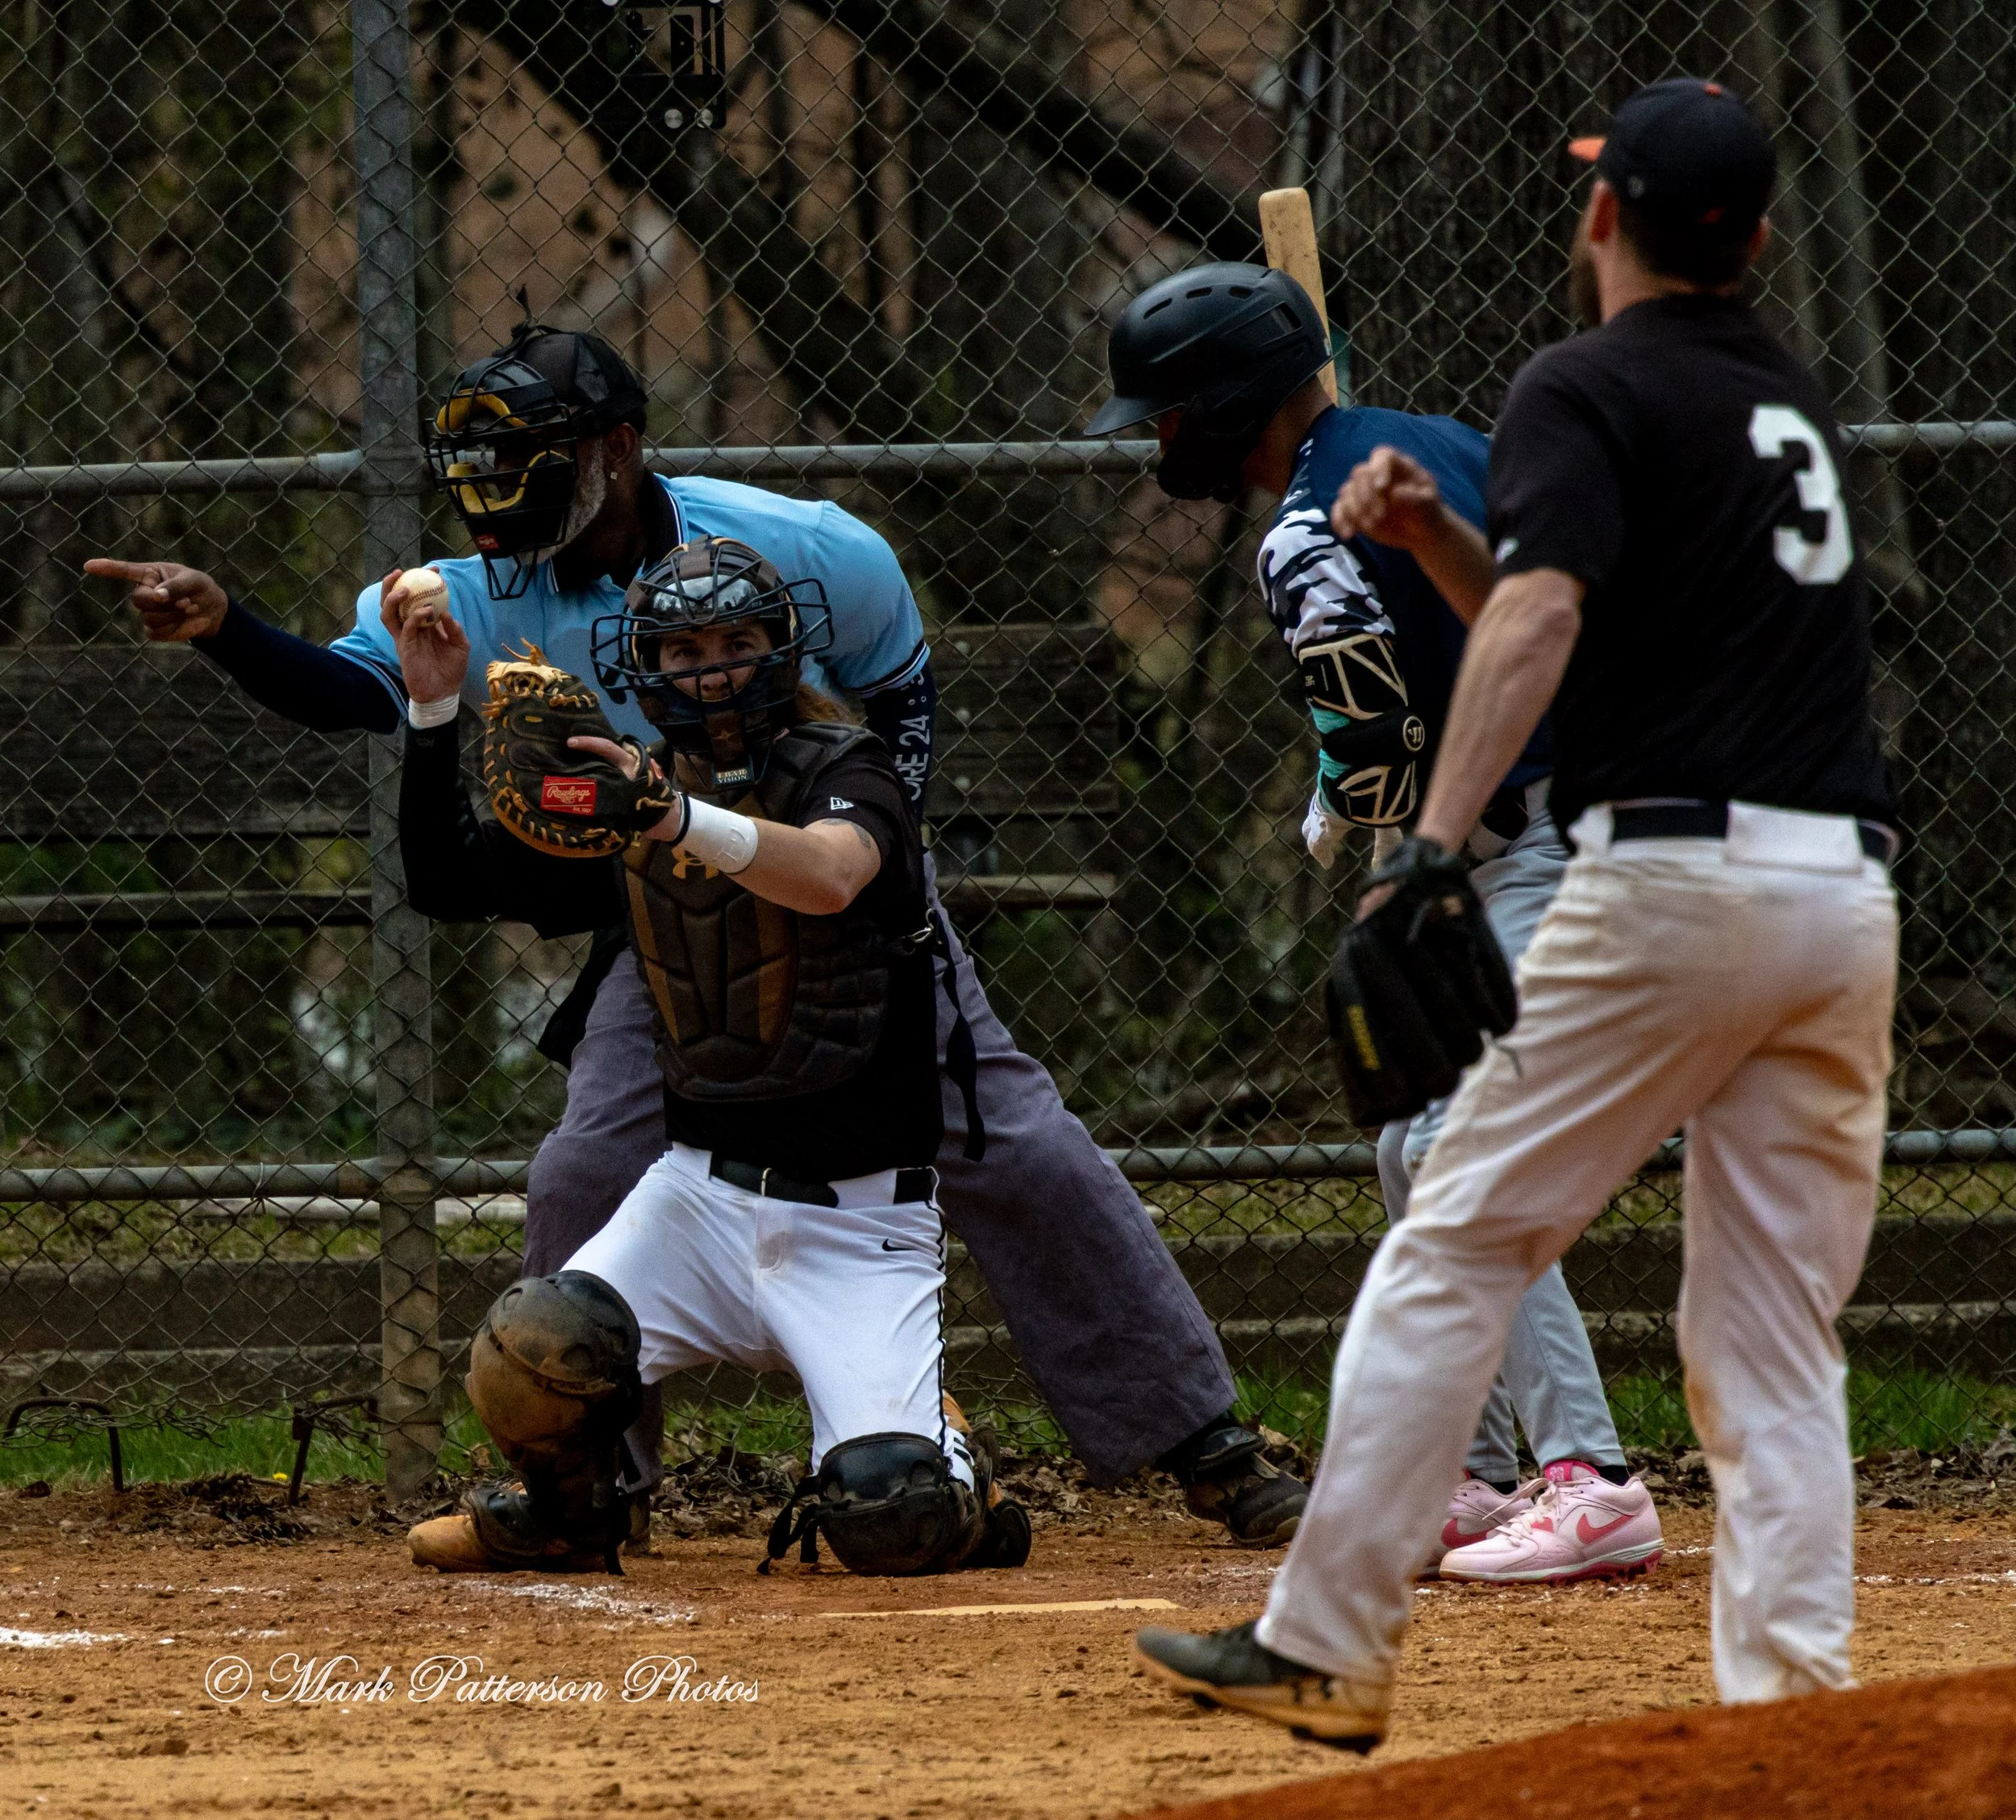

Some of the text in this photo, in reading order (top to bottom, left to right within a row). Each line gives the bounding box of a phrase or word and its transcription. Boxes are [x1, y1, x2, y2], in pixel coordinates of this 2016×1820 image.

[1747, 403, 1854, 586] 3
[718, 774, 747, 784] VISION
[547, 785, 591, 803] Rawlings
